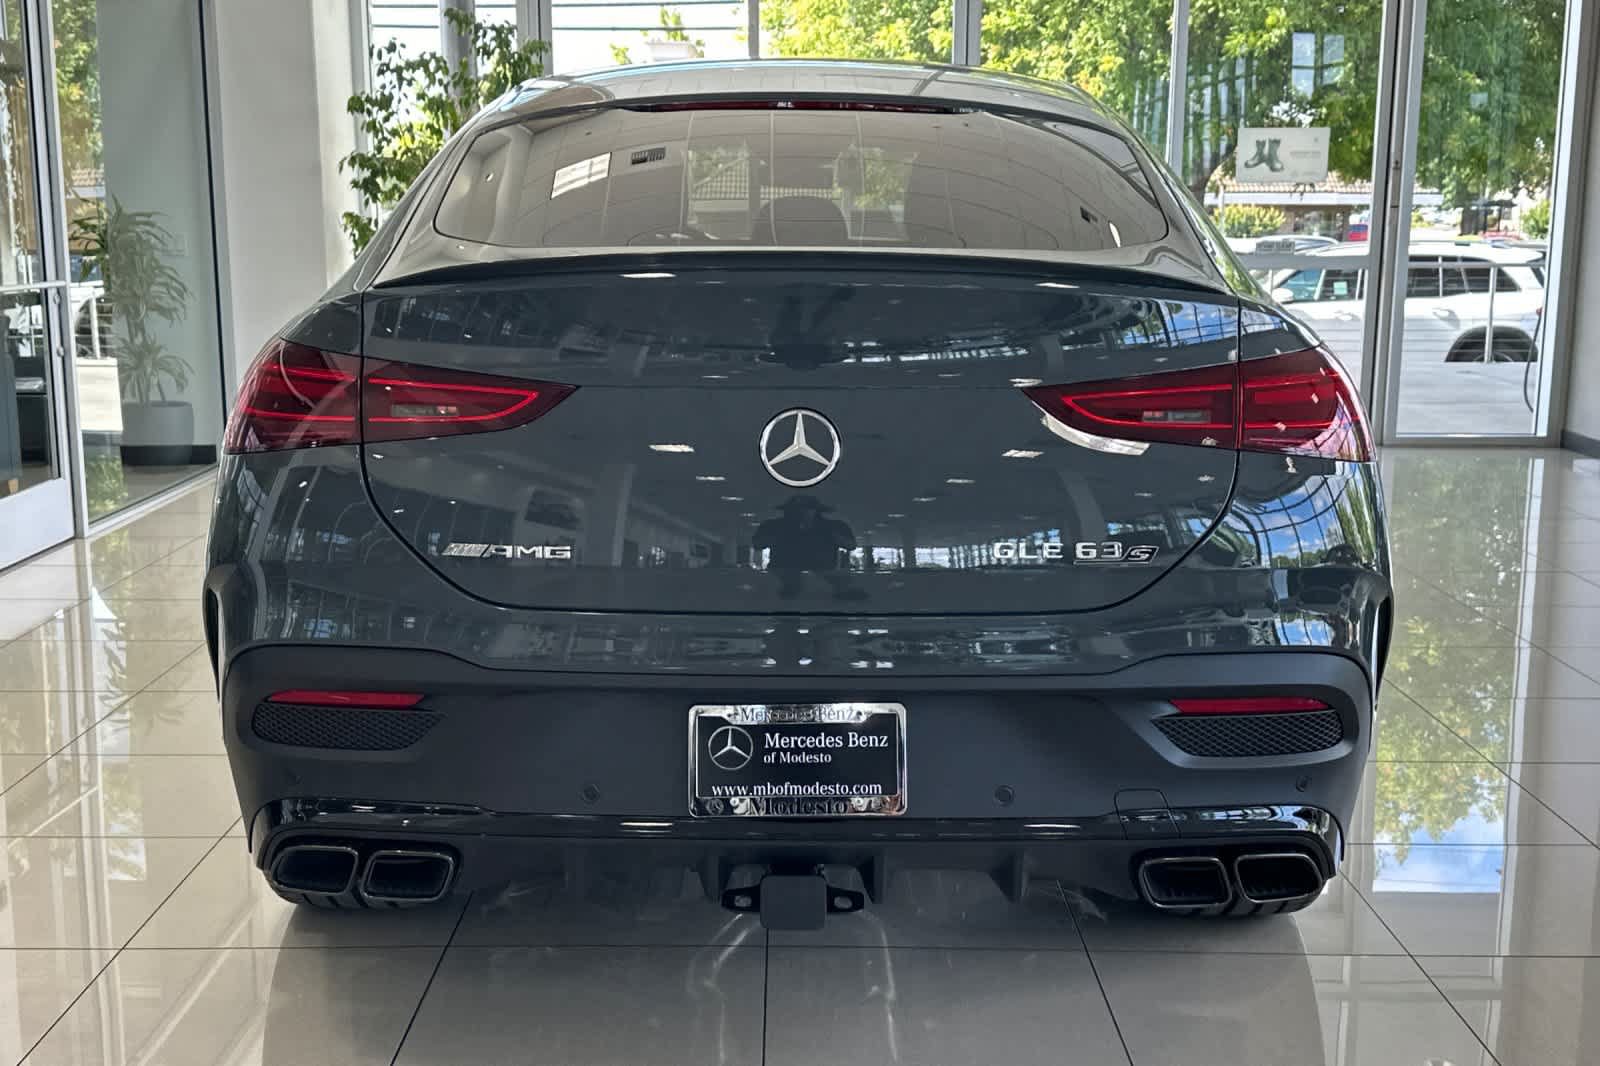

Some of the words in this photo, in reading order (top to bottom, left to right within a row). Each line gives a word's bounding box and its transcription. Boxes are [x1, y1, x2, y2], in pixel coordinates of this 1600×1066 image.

[483, 544, 571, 559] AMG
[993, 542, 1064, 559] GLE
[764, 732, 843, 749] Mercedes
[847, 731, 889, 747] Benz
[763, 751, 777, 763] of
[779, 751, 832, 763] Modesto
[712, 781, 883, 796] www.mbofmodesto.com
[748, 797, 850, 816] Modesto
